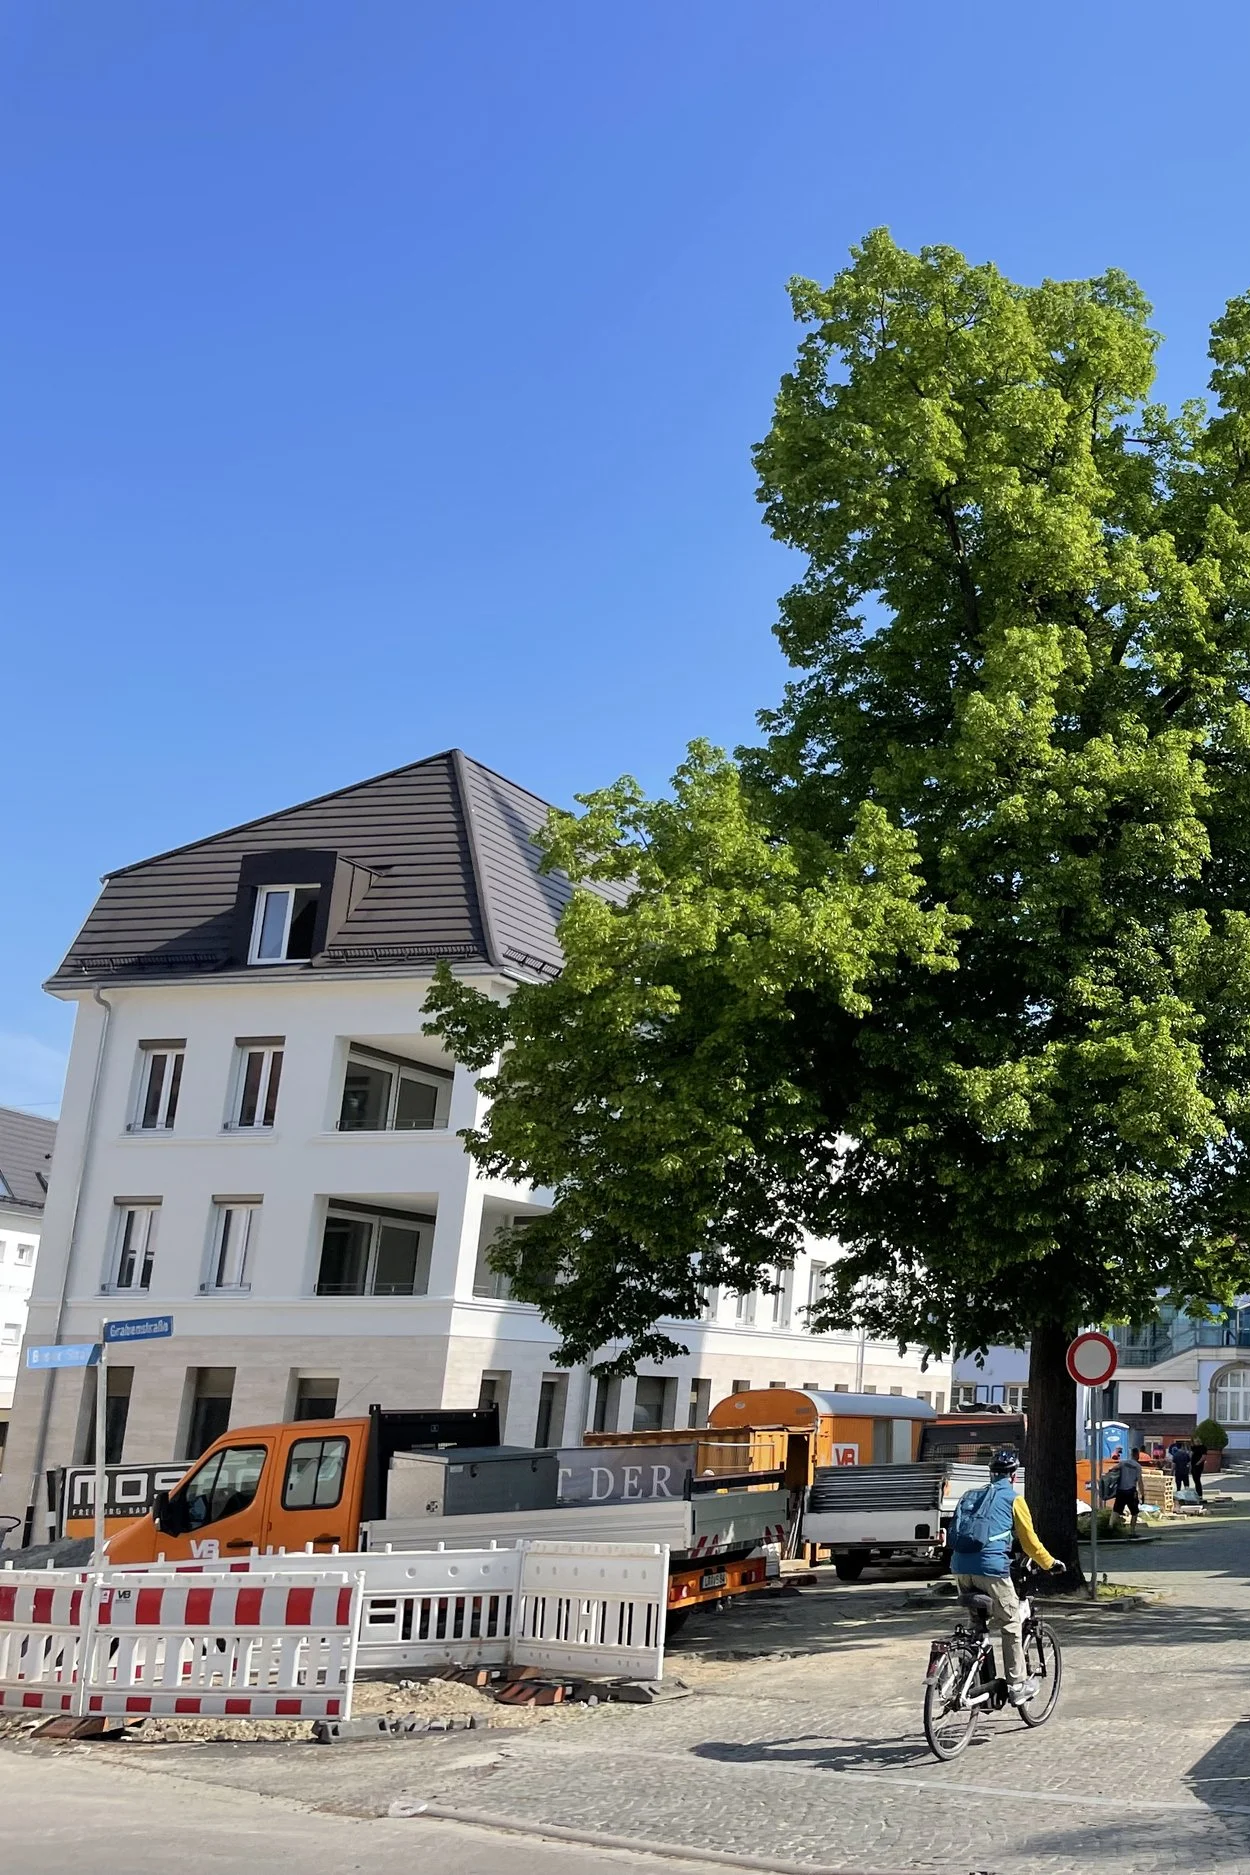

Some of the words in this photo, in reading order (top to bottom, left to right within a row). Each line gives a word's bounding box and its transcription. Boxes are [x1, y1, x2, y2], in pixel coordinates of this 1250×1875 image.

[110, 1320, 169, 1337] Grabenstraße
[588, 1465, 672, 1500] DER
[190, 1539, 219, 1559] VB
[117, 1590, 131, 1599] VB
